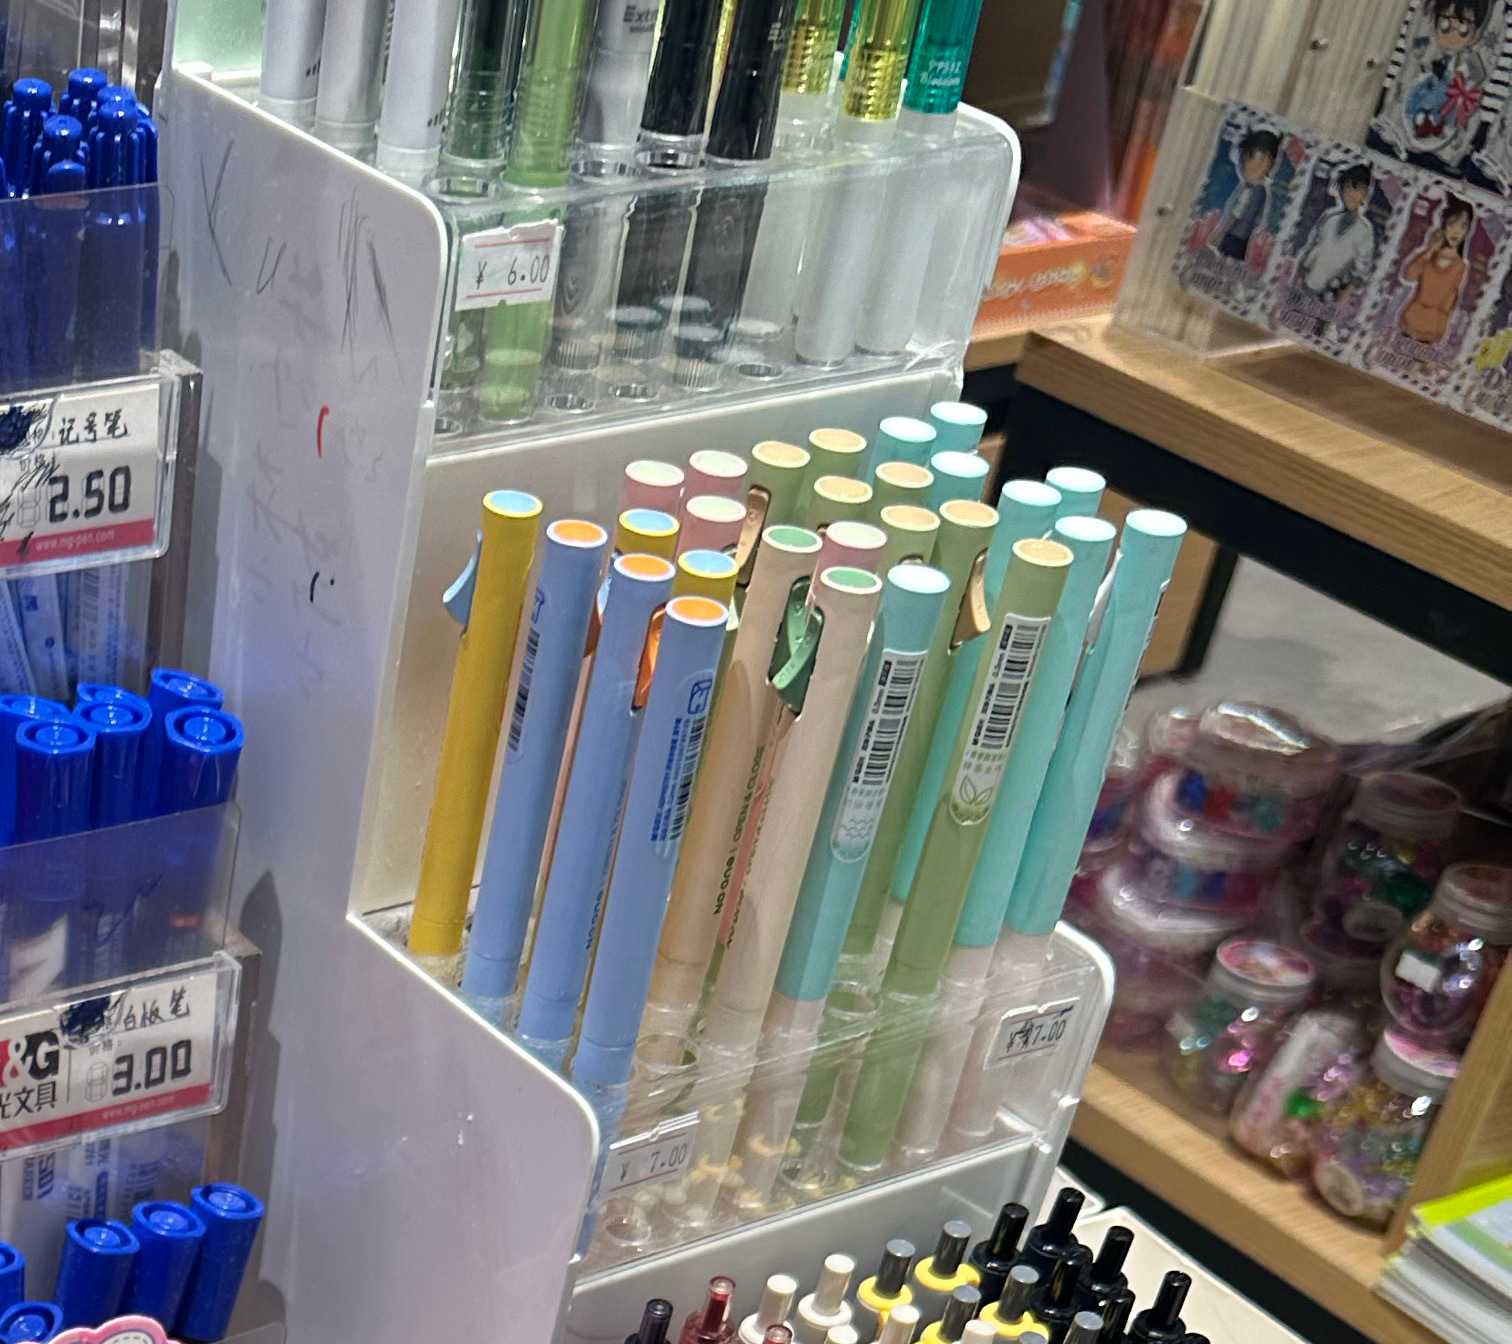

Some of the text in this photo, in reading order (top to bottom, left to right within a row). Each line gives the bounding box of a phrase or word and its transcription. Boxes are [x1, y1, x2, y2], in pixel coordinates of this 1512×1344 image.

[508, 253, 550, 286] 6.00
[59, 408, 128, 446] 记号笔
[48, 465, 131, 523] 2.50
[123, 986, 190, 1031] 白板笔
[112, 1039, 192, 1096] 3.00
[651, 1142, 688, 1174] 7.00
